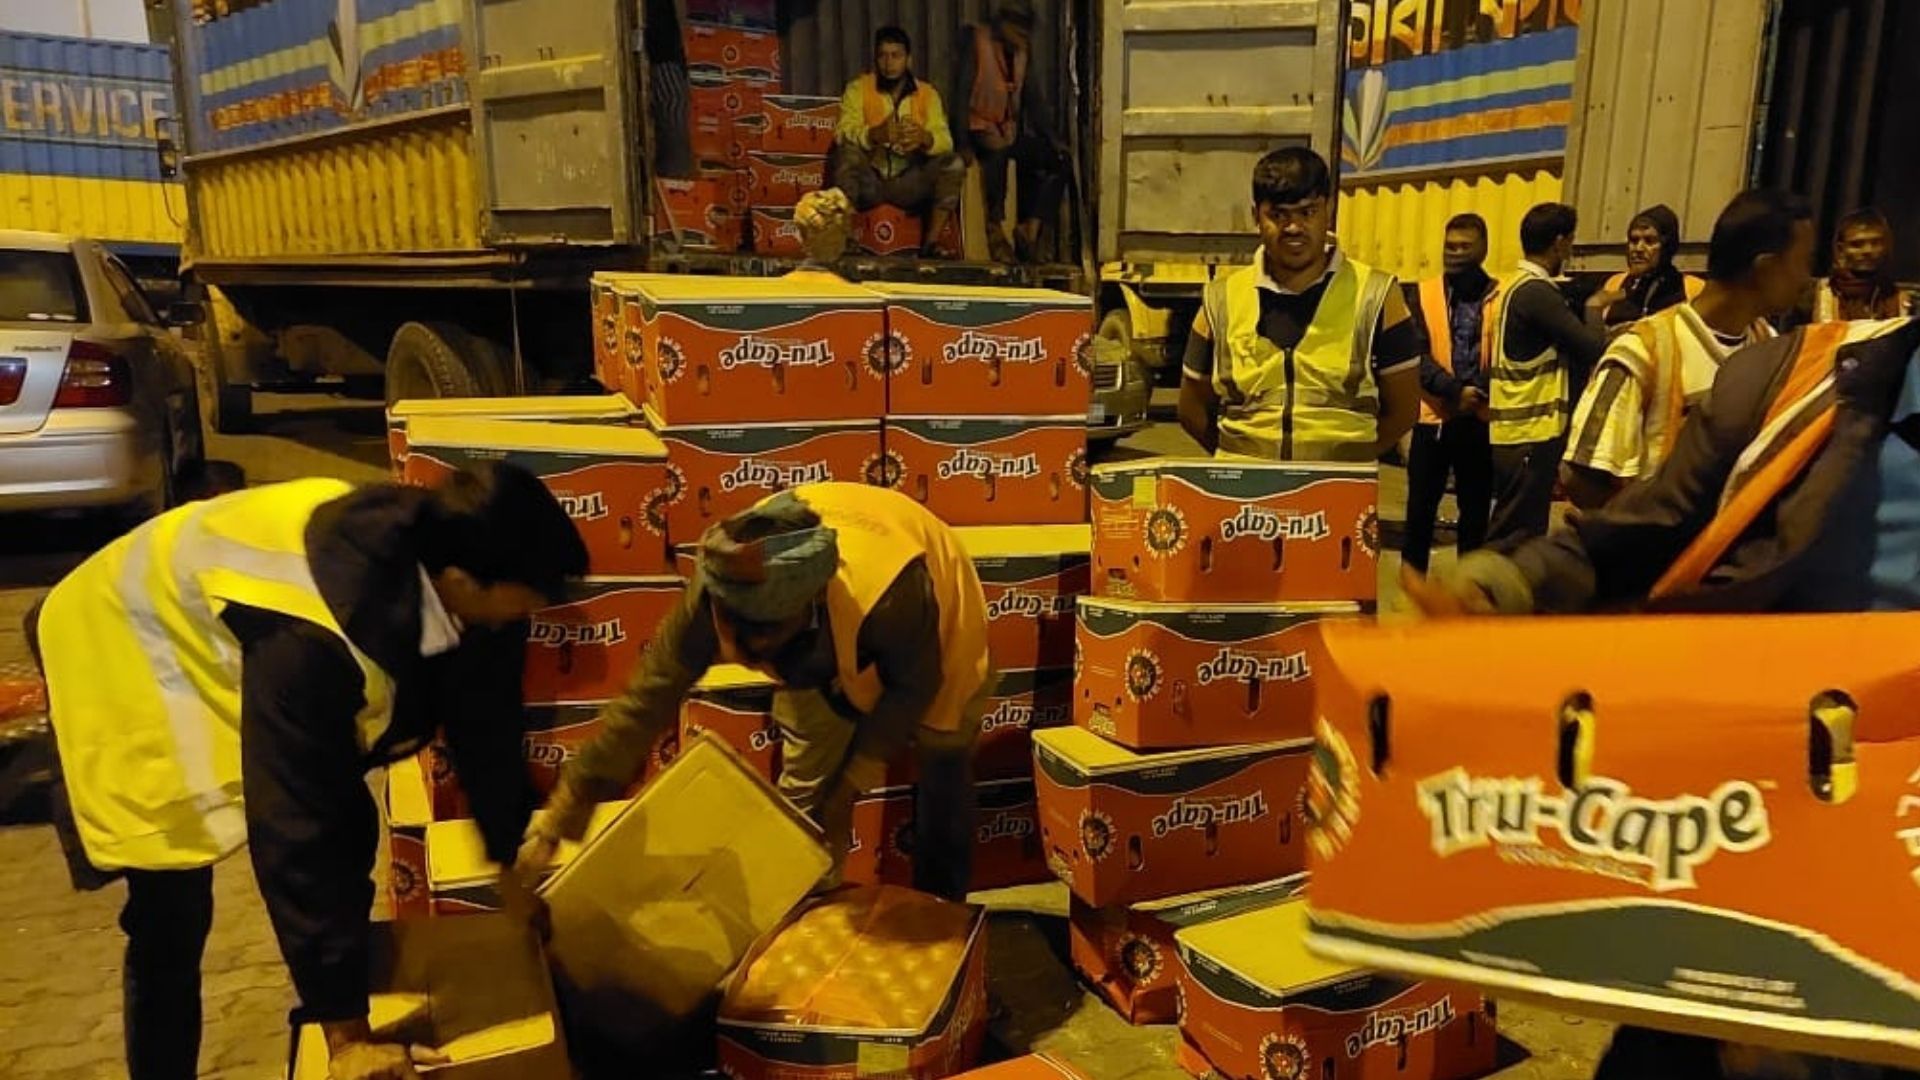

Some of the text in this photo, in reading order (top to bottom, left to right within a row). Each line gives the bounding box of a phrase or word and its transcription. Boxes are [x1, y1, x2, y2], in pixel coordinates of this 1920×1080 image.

[719, 335, 834, 370] Tru-Cape
[943, 331, 1047, 363] Tru-Cape
[720, 457, 833, 492] Tru-Cape
[937, 449, 1040, 479] Tru-Cape
[1220, 503, 1330, 541] Tru-Cape
[986, 587, 1075, 621] ru-Cape
[1197, 646, 1311, 686] Tru-Cape
[1152, 790, 1269, 838] Tru-Cape
[1417, 767, 1770, 891] Tru-Cape
[1345, 994, 1455, 1058] Tru-Cape
